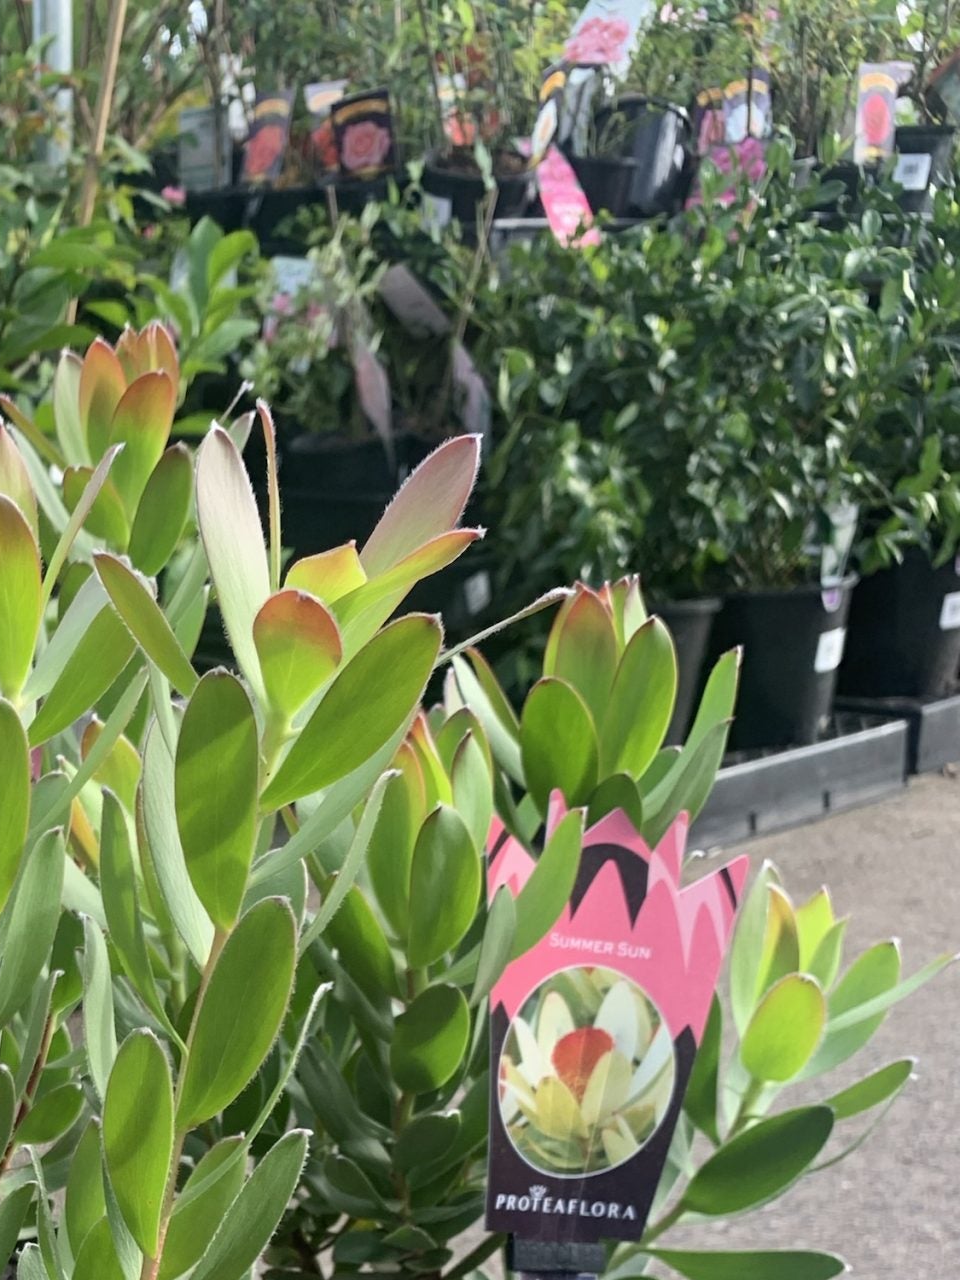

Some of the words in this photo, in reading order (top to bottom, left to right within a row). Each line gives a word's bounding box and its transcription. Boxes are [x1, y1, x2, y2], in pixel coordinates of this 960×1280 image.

[550, 933, 614, 954] SUMMER
[617, 941, 651, 959] SUN
[495, 1193, 637, 1221] PROTEAFLORA
